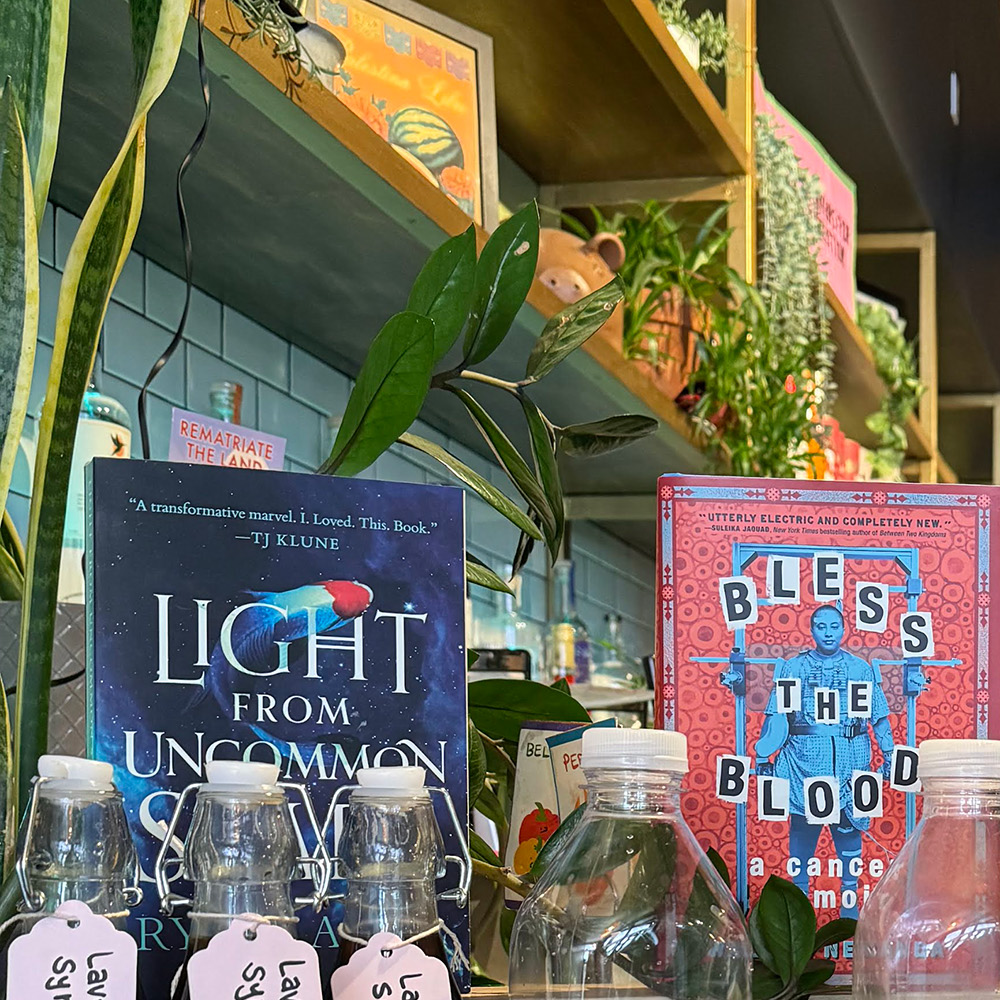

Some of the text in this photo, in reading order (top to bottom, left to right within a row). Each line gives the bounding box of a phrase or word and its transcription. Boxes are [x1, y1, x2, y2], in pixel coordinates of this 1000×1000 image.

[180, 420, 273, 460] REMATRIATE
[187, 442, 215, 464] THE
[151, 502, 246, 519] transformative
[249, 510, 297, 523] marvel.
[300, 512, 310, 524] I.
[313, 513, 355, 529] Loved.
[359, 517, 390, 531] This.
[760, 514, 814, 525] ELECTRIC
[817, 516, 839, 526] AND
[842, 517, 913, 528] COMPLETELY
[772, 526, 786, 534] New
[801, 527, 819, 535] Times
[819, 528, 851, 536] bestselling
[276, 534, 340, 550] KLUNE
[724, 557, 929, 653] BLESS
[153, 593, 428, 695] LIGHT
[232, 693, 351, 726] FROM
[778, 680, 868, 720] THE
[123, 730, 447, 784] UNCOMMON
[719, 749, 919, 818] BLOOD
[750, 857, 893, 878] a cance
